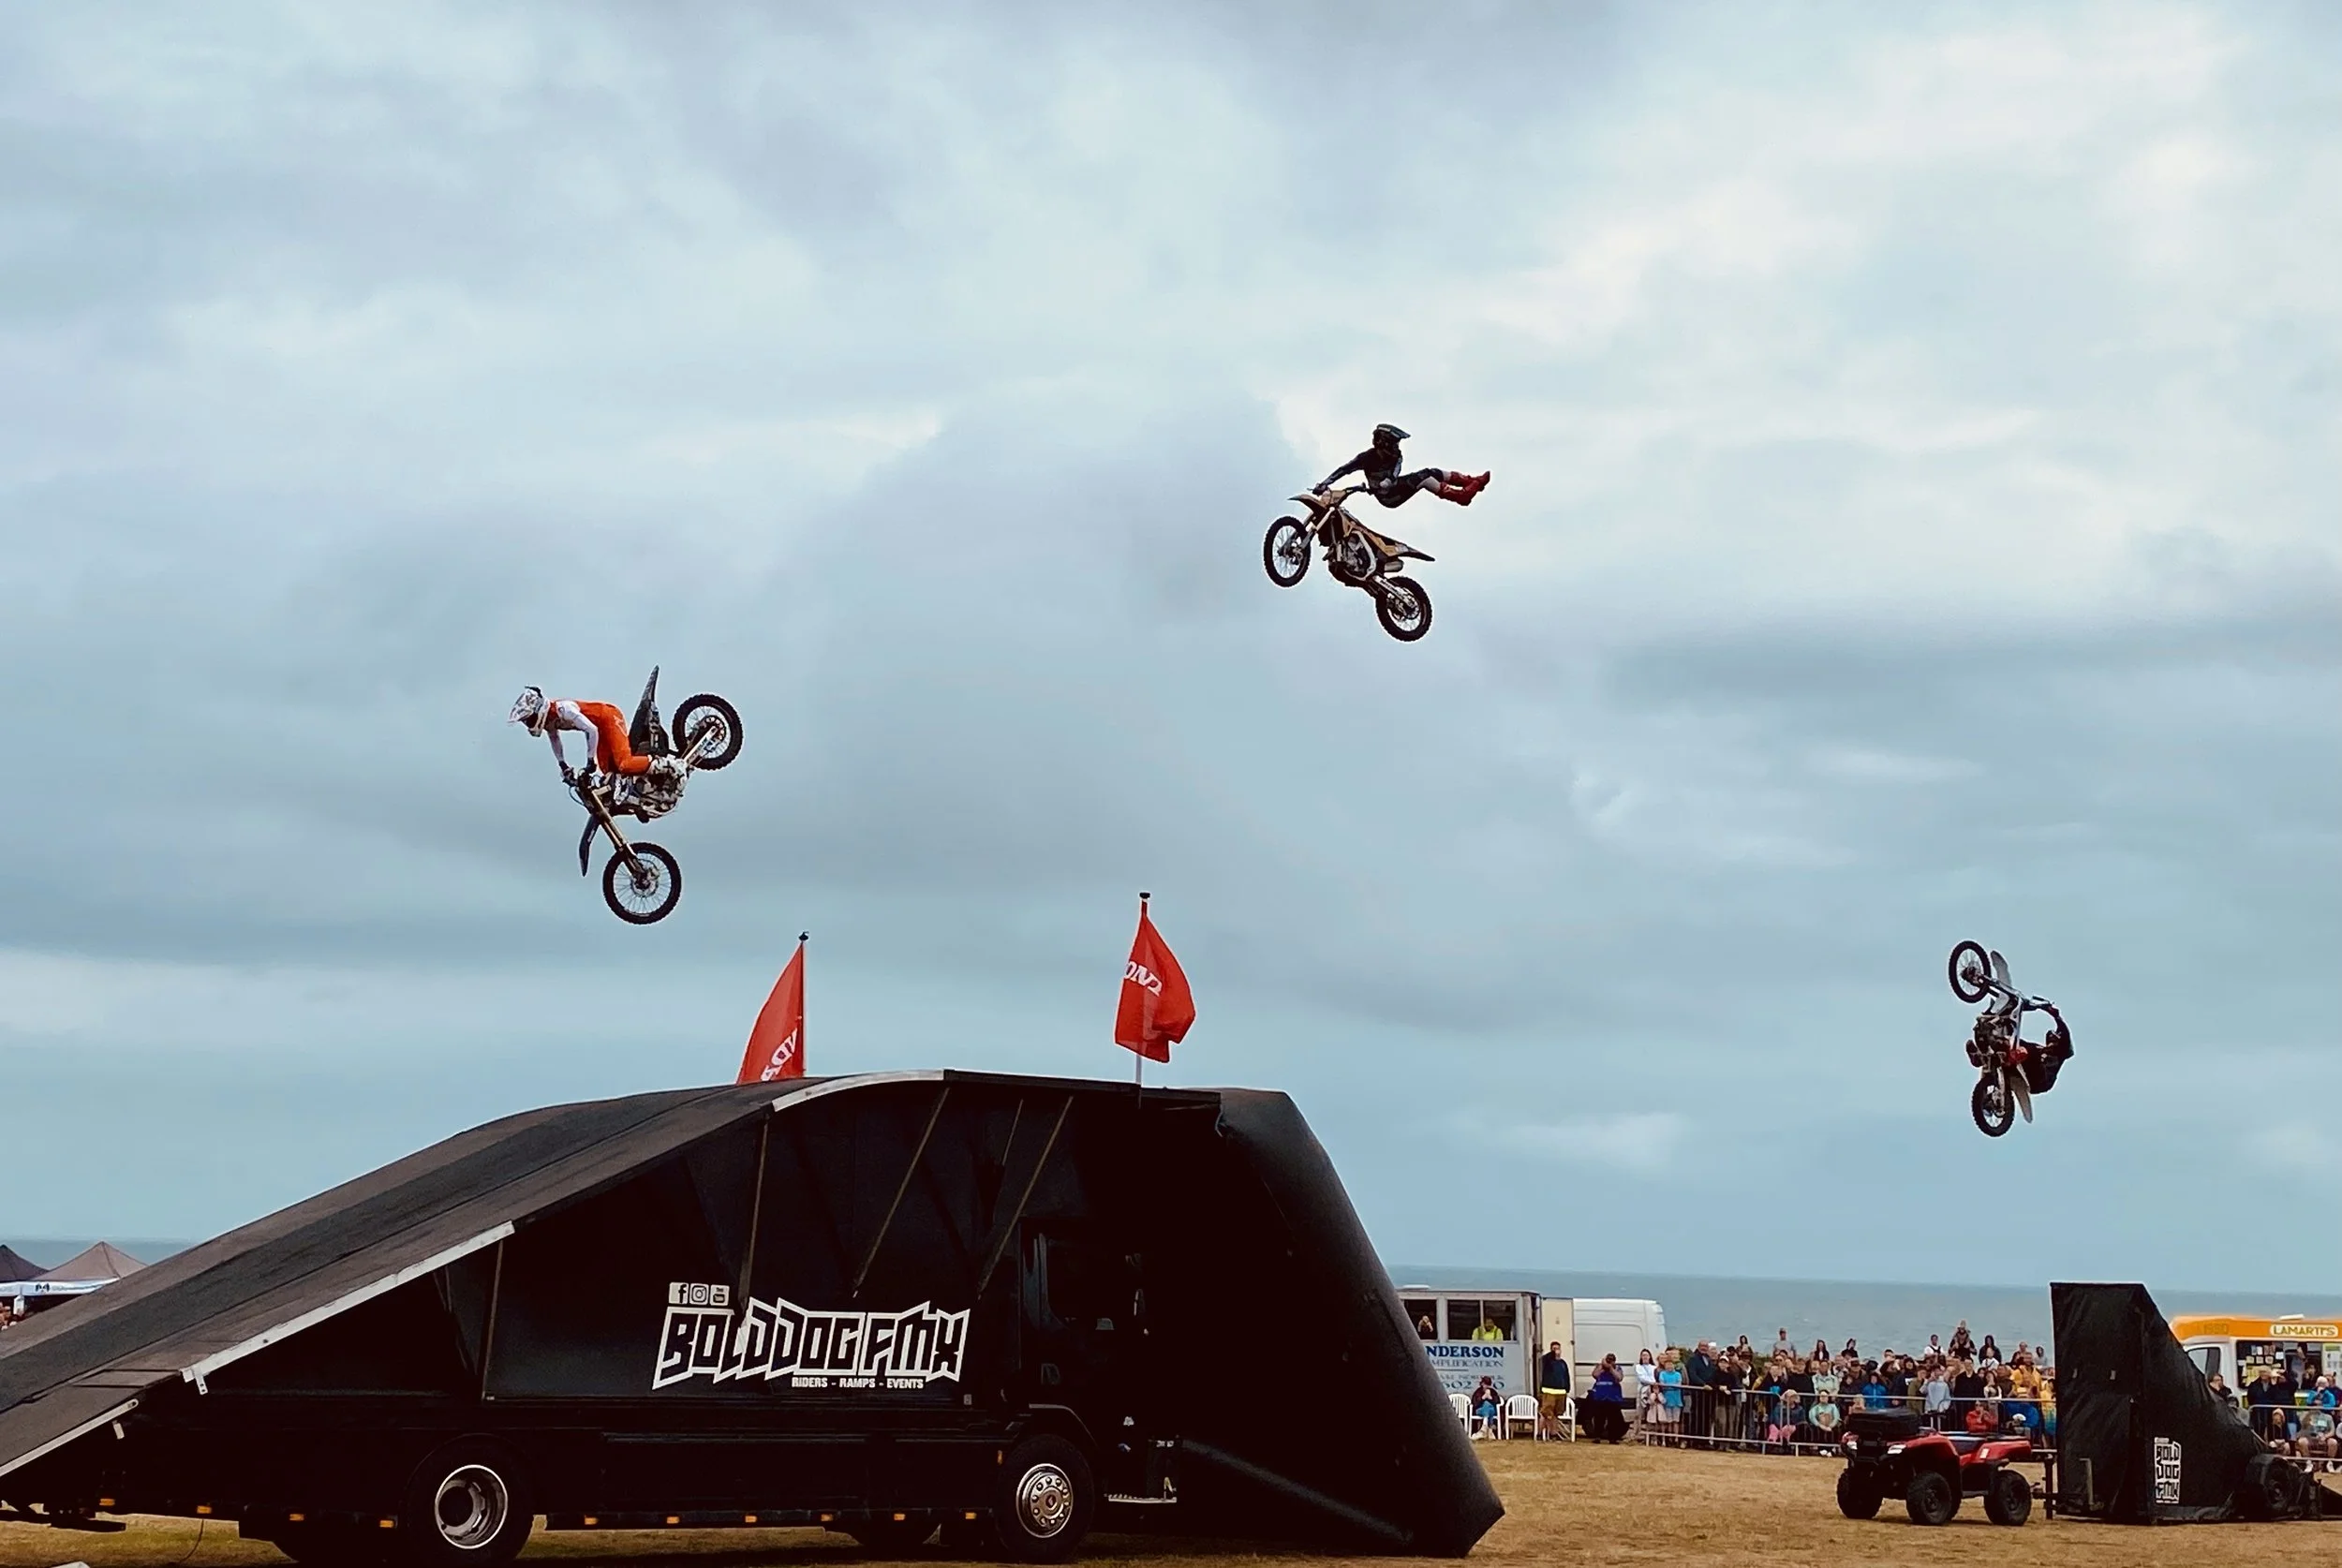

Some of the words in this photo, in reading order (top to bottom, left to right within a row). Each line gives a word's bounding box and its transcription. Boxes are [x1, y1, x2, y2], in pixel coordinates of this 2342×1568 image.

[792, 1377, 828, 1388] RIDERS
[839, 1378, 876, 1389] RAMPS
[886, 1379, 924, 1389] EVENTS
